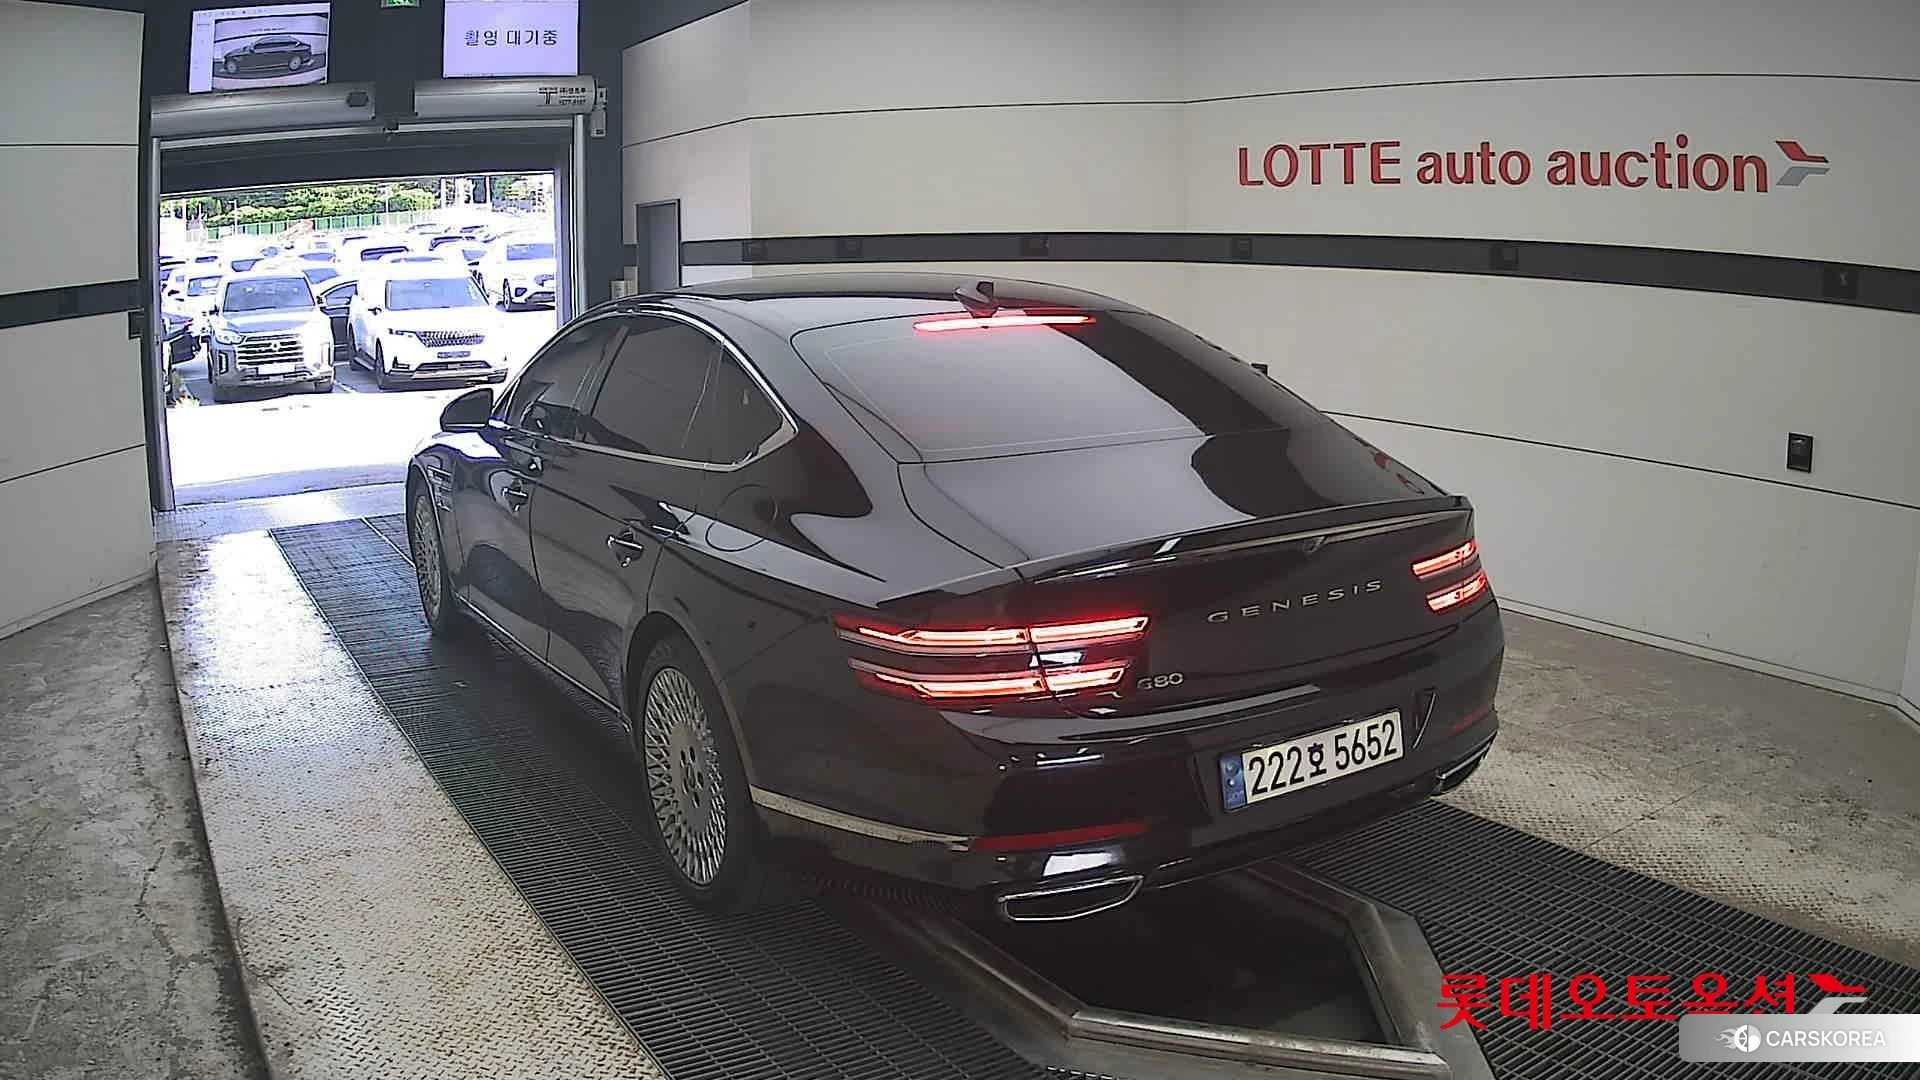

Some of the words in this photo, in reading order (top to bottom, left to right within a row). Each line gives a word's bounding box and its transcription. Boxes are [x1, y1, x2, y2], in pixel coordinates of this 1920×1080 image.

[464, 30, 498, 46] 촬영
[506, 30, 558, 46] 대기중
[1238, 141, 1401, 187] LOTTE
[1416, 141, 1532, 186] auto
[1546, 134, 1769, 194] auction
[1207, 579, 1383, 623] GENESIS
[1137, 672, 1185, 690] G80
[1248, 743, 1327, 796] 222호
[1334, 719, 1398, 770] 5652
